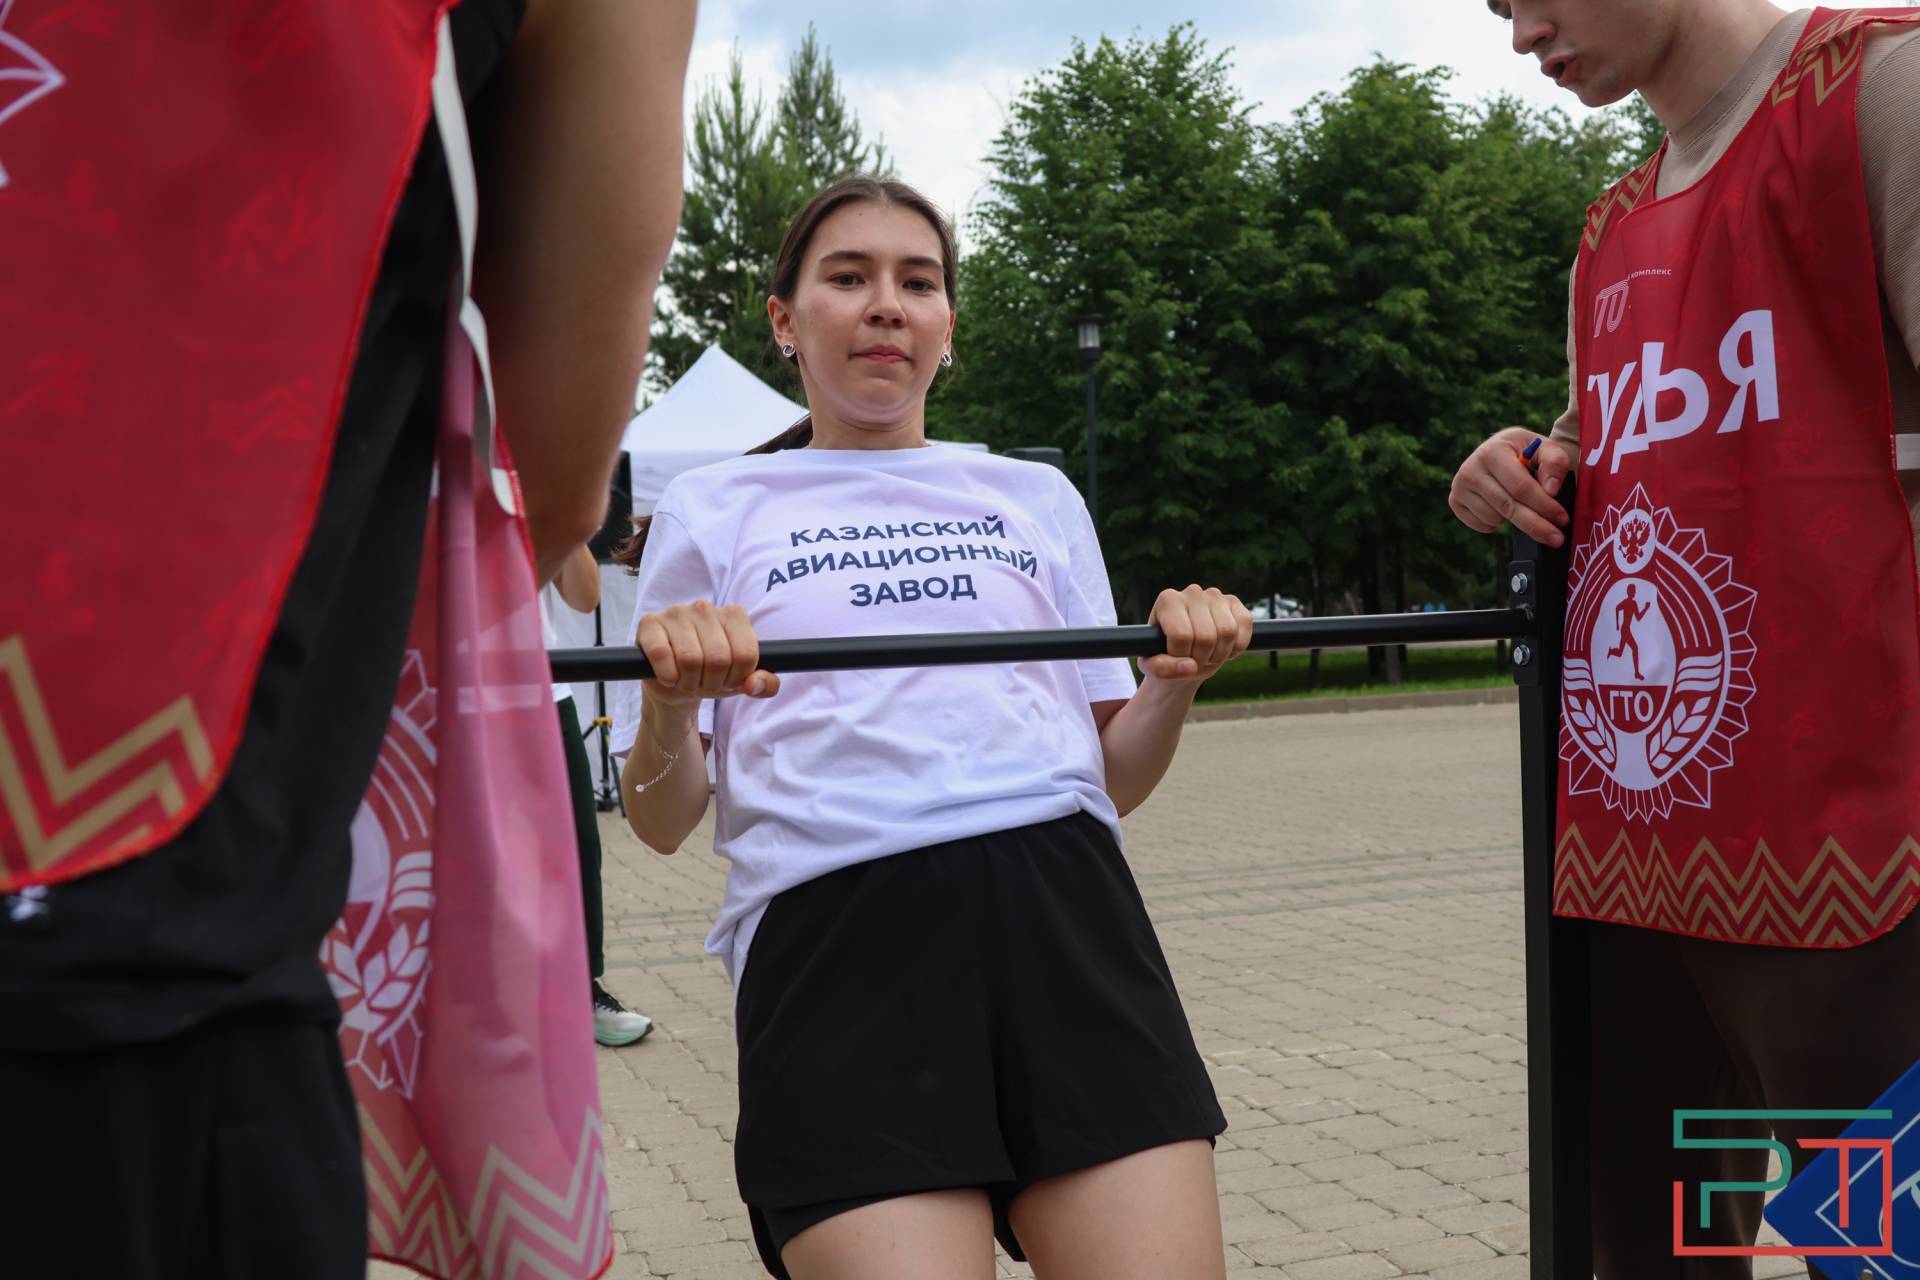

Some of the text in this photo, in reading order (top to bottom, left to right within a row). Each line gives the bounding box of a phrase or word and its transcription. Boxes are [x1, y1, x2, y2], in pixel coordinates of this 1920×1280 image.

[1630, 267, 1673, 280] комплекс
[1585, 309, 1781, 475] УДЬЯ
[790, 514, 1006, 548] КАЗАНСКИЙ
[765, 543, 1038, 592] АВИАЦИОННЫЙ
[849, 574, 978, 607] ЗАВОД
[1609, 690, 1654, 724] ГТО
